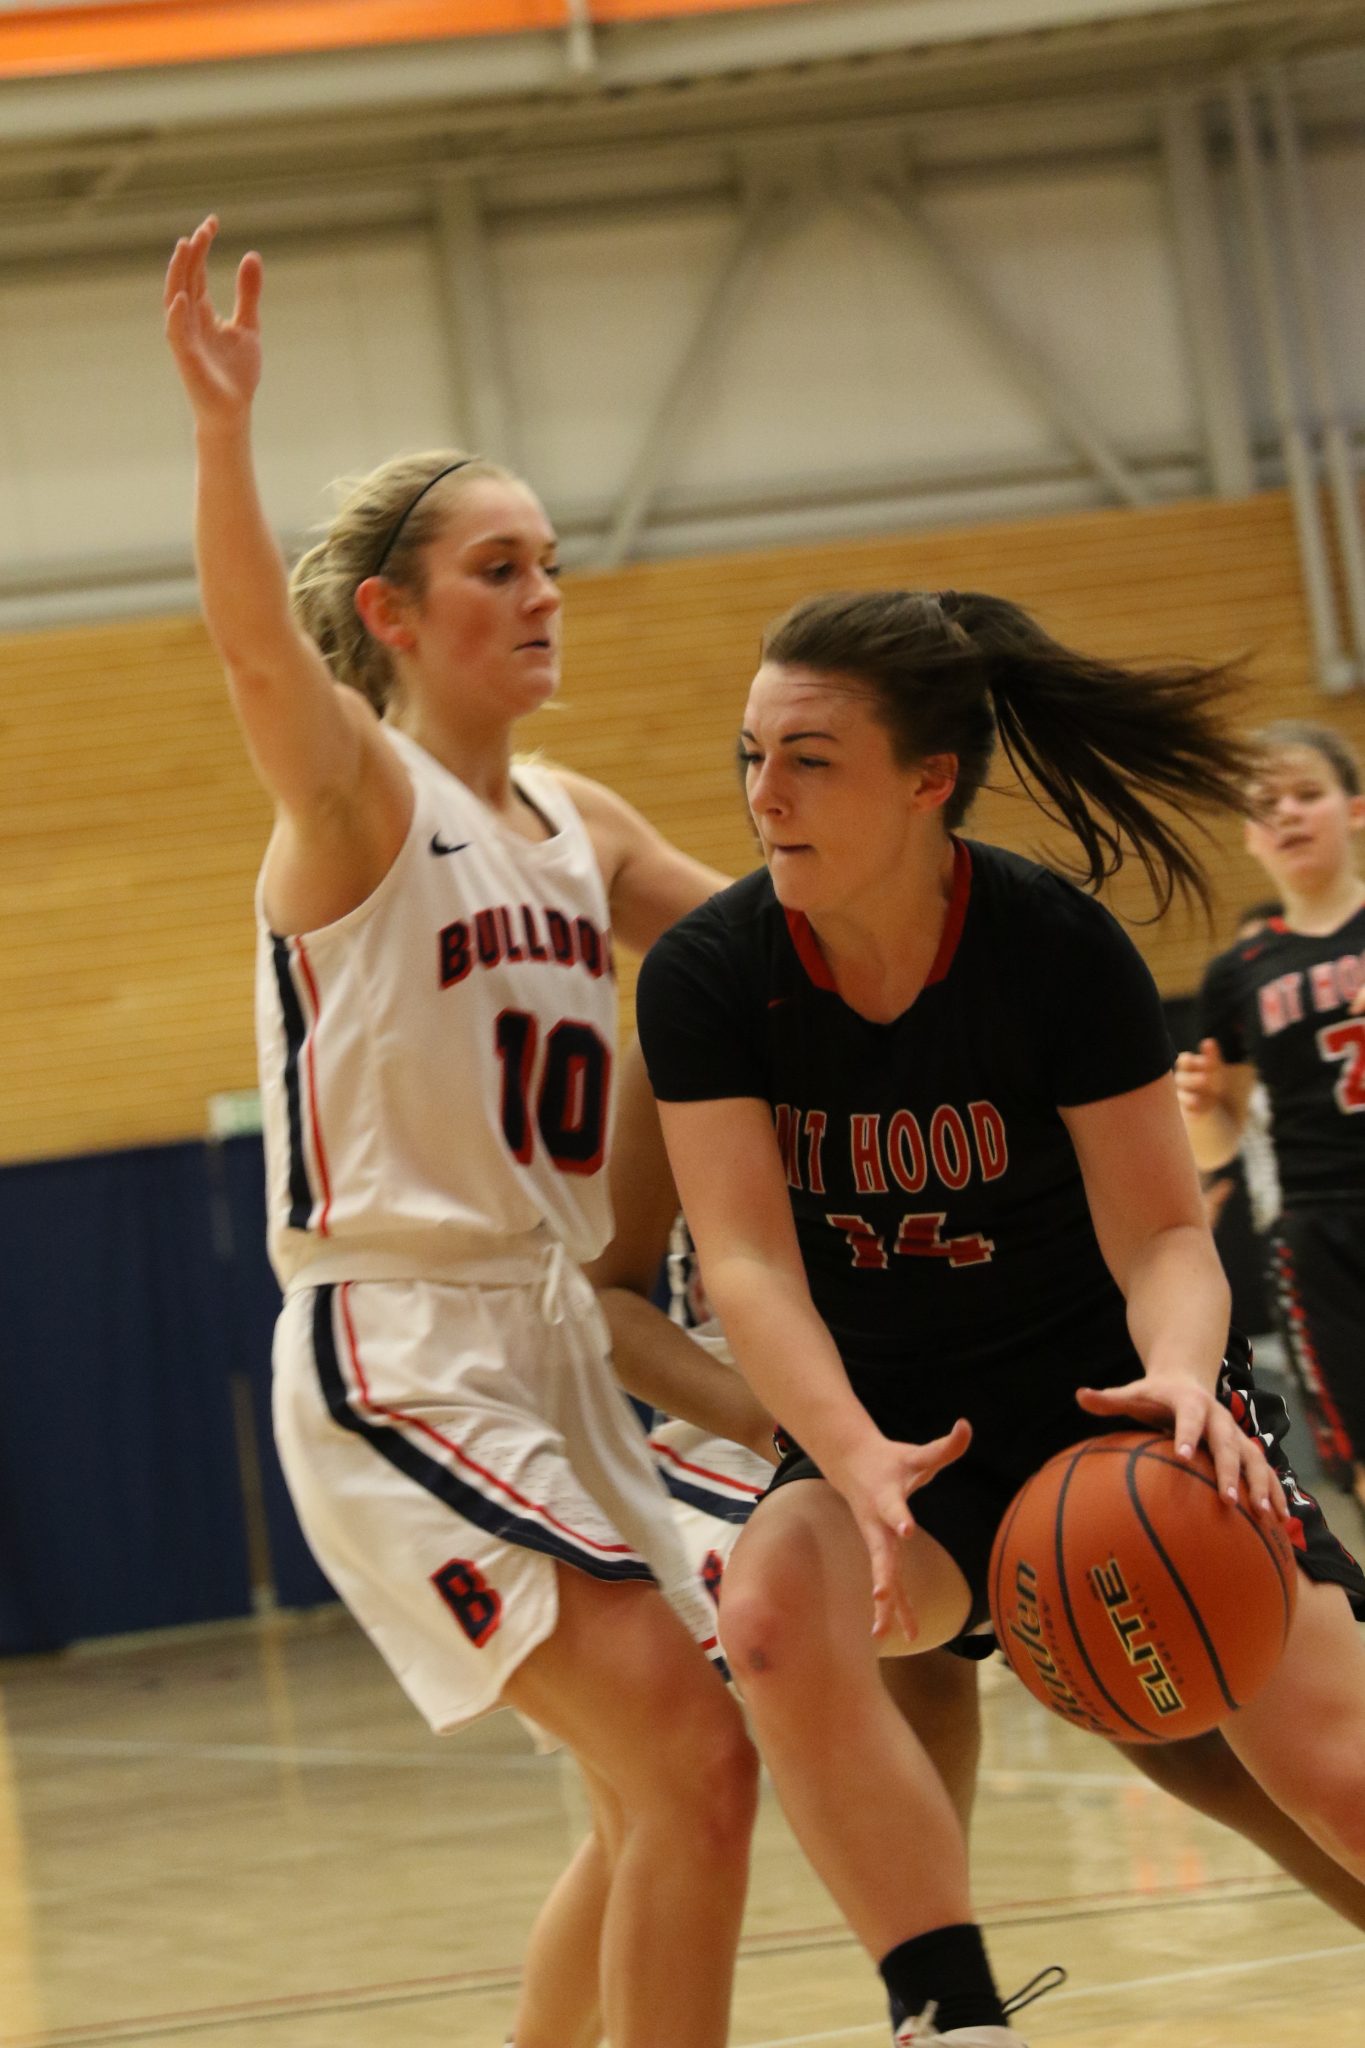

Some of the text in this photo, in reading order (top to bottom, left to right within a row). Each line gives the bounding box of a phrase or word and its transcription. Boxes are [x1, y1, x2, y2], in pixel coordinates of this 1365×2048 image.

[438, 903, 615, 990] BULLDO
[494, 1007, 612, 1178] 10
[850, 1100, 1008, 1194] HOOD
[825, 1212, 995, 1269] 14
[429, 1557, 504, 1649] B
[1091, 1558, 1186, 1717] ELITE
